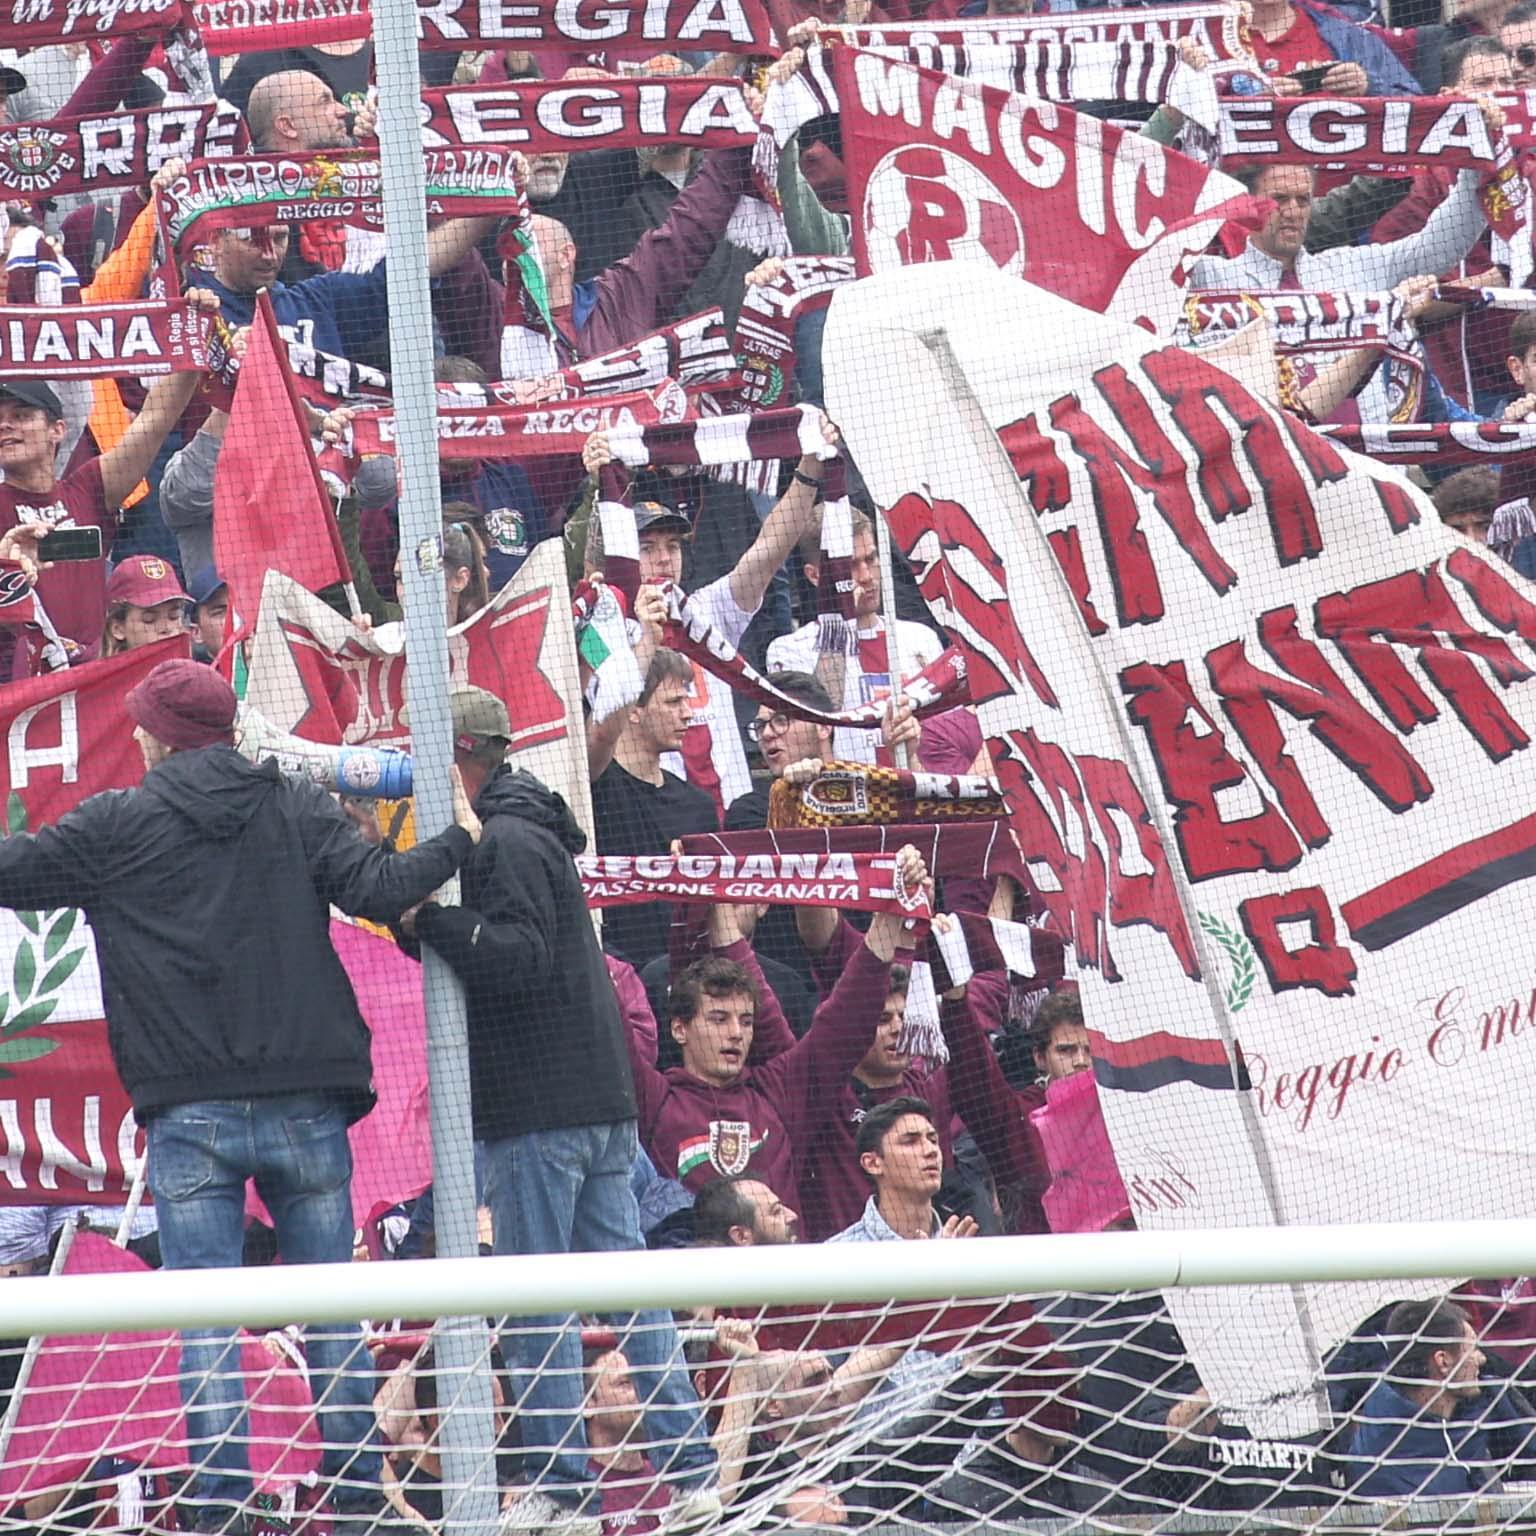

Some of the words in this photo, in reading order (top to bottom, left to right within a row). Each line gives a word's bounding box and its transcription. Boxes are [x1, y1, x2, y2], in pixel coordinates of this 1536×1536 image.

[1221, 99, 1495, 163] EGIA
[377, 413, 517, 443] FRZA
[724, 880, 860, 902] GRANATA
